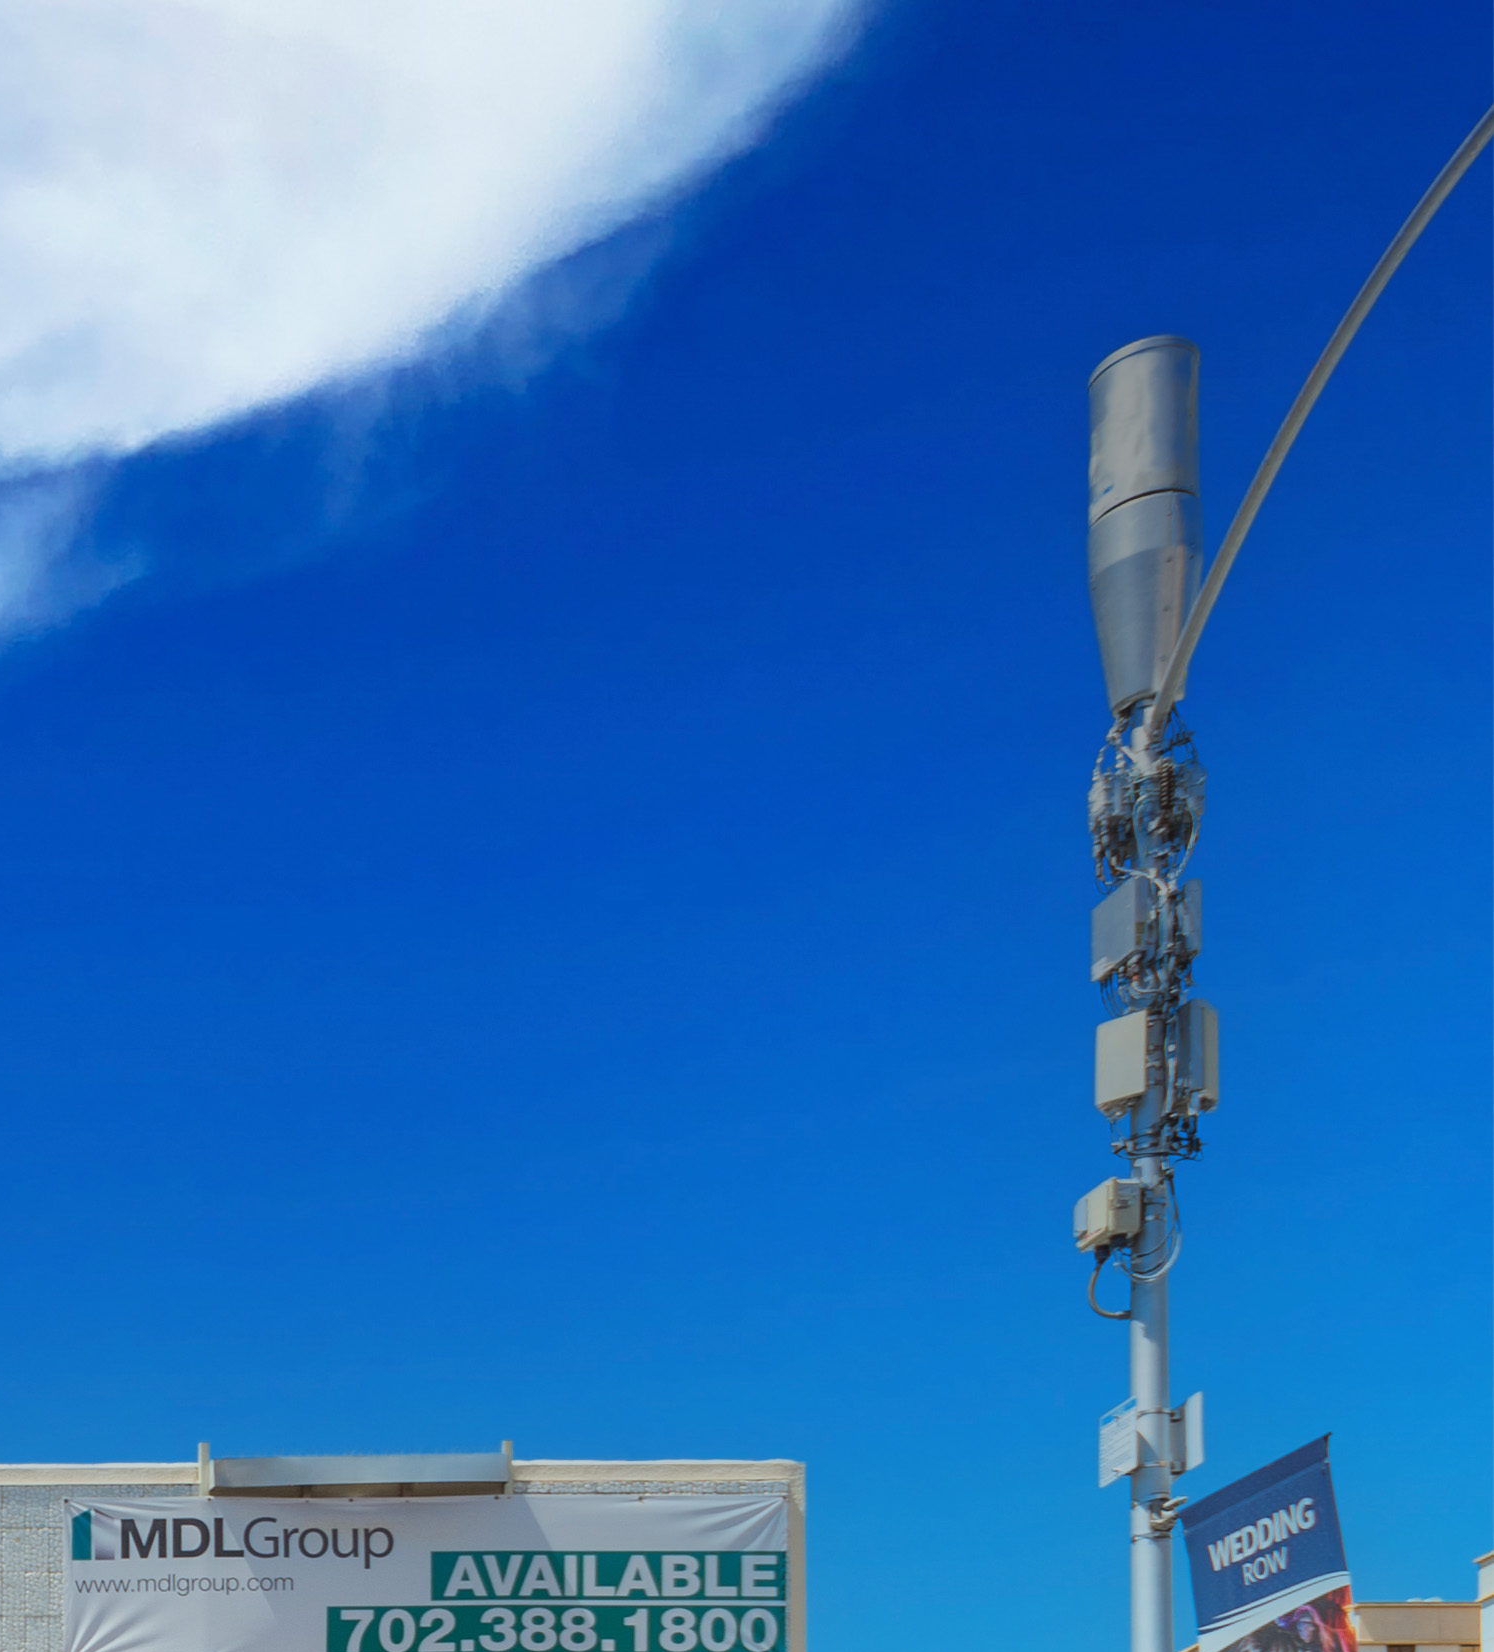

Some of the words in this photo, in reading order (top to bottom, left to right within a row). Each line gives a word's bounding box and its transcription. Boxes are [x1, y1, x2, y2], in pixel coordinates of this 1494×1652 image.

[119, 1517, 395, 1569] MDLGroup
[1207, 1497, 1316, 1571] WEDDING
[74, 1573, 295, 1596] www.mdlgroup.com
[443, 1555, 779, 1598] AVAILABLE
[1242, 1546, 1288, 1585] ROW
